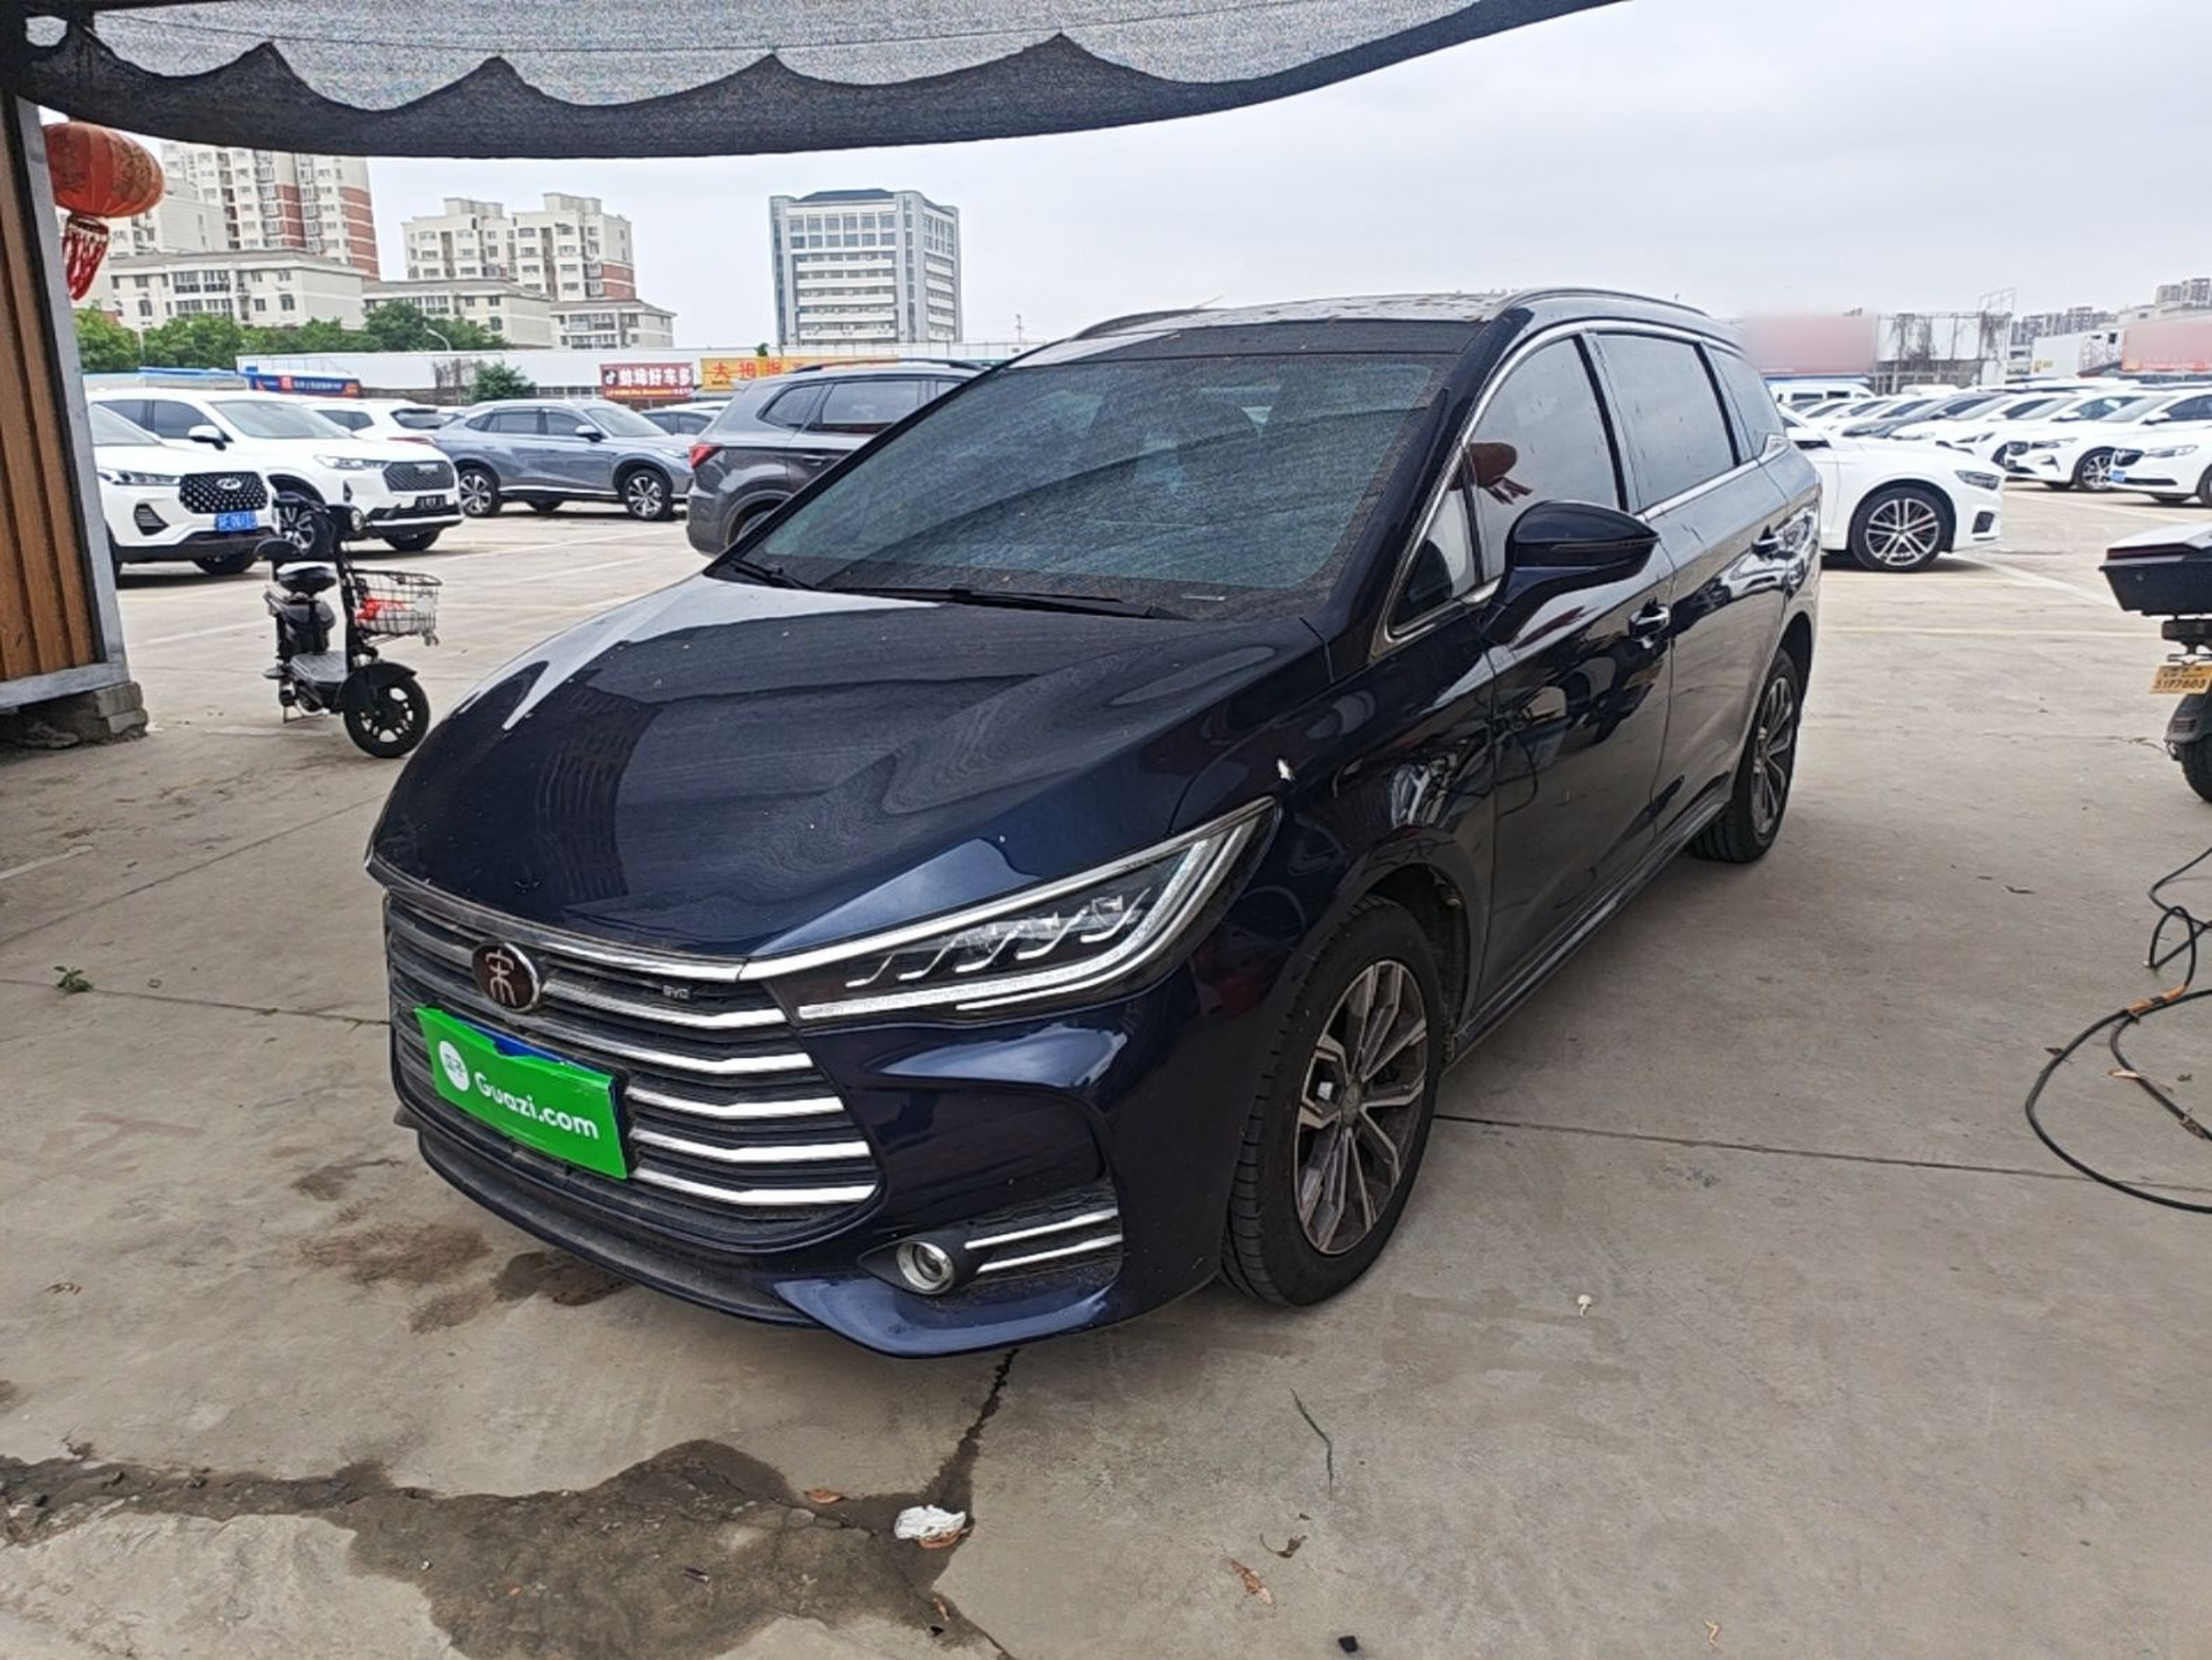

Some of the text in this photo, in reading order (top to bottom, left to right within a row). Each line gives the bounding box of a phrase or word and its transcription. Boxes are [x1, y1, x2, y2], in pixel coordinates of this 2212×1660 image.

[714, 358, 804, 379] 大拇指
[474, 1072, 599, 1140] Guazi.com
